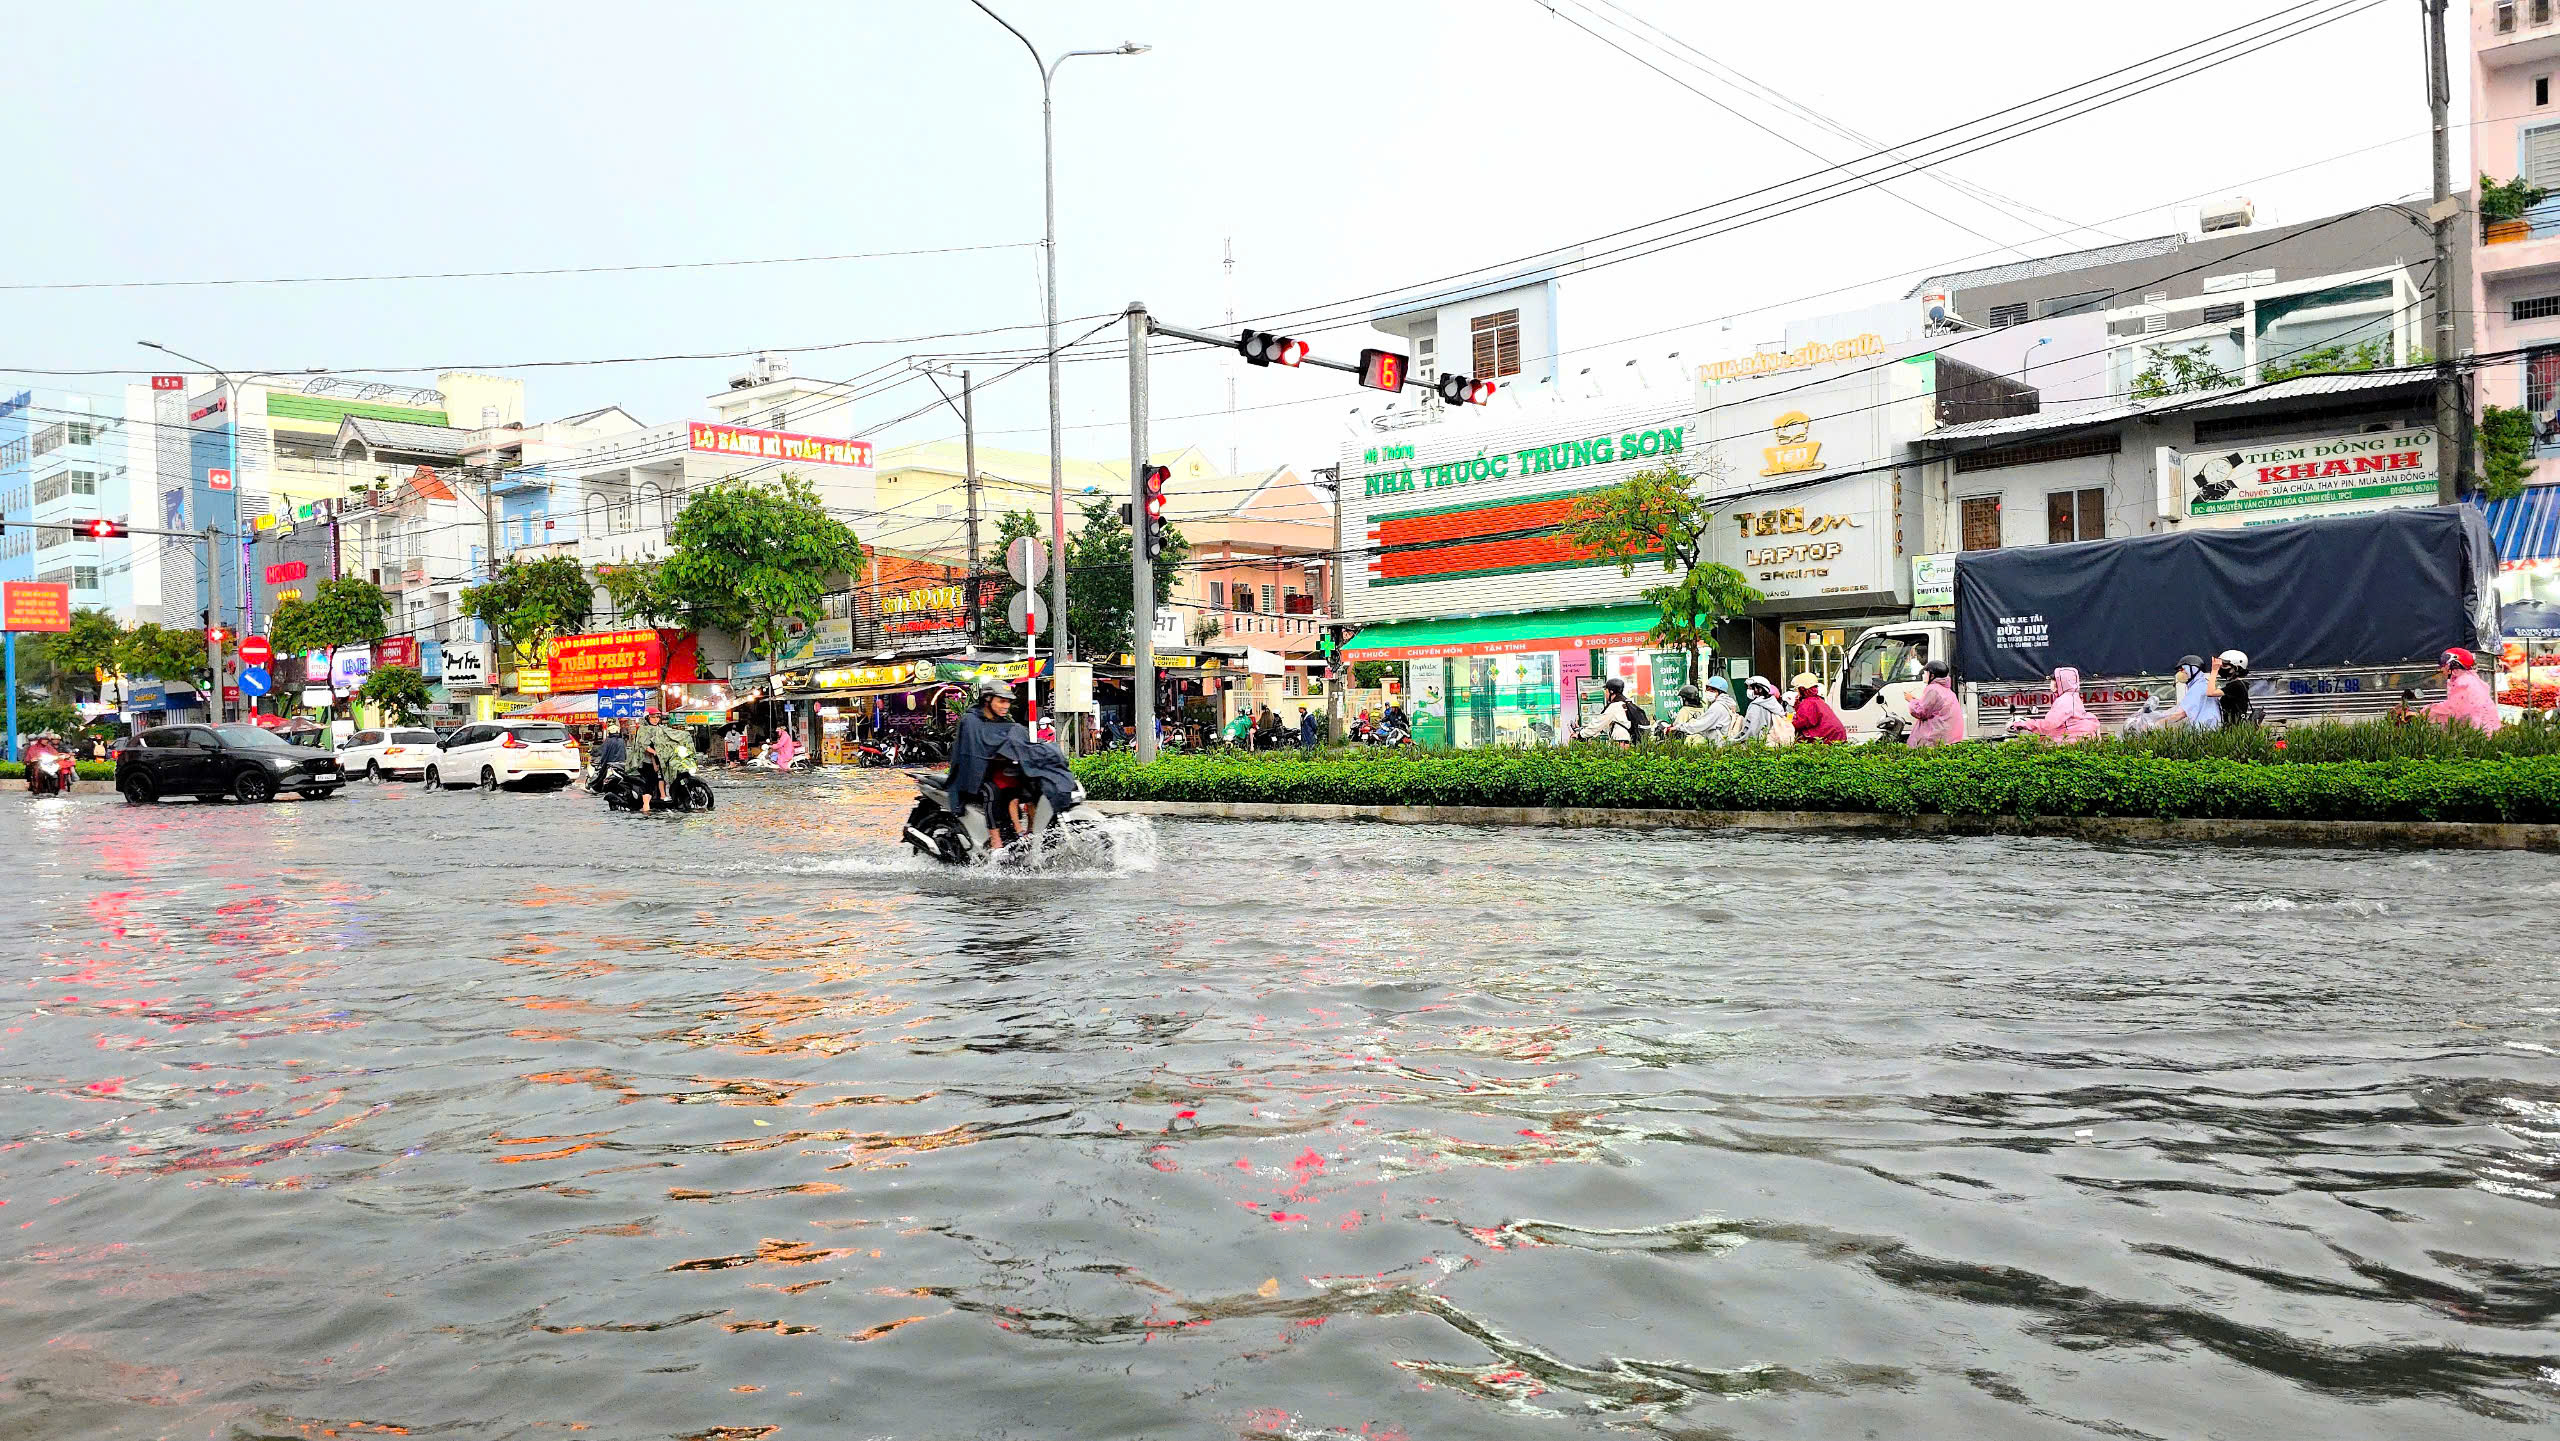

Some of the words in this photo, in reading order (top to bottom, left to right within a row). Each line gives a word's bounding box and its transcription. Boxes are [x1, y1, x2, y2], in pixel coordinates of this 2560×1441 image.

[1381, 358, 1396, 387] 6
[718, 430, 760, 453] BÁNH
[824, 442, 861, 464] PHÁT
[1382, 441, 1415, 461] Thống
[2245, 449, 2305, 465] TIỆM
[2393, 430, 2431, 448] HỒ
[1364, 462, 1416, 496] NHÀ
[1421, 445, 1509, 488] THUỐC
[1517, 437, 1614, 475] TRUNG
[2257, 452, 2423, 485] KHANH
[2239, 489, 2271, 498] Chuyên:
[2272, 484, 2290, 495] SỬA
[2318, 481, 2339, 490] THAY
[2359, 477, 2378, 486] MUA
[2380, 473, 2398, 484] BÁN
[2400, 471, 2426, 481] ĐỒNG
[2217, 501, 2241, 512] NGUYỄN
[2244, 500, 2257, 510] VĂN
[2284, 496, 2297, 505] HÒA
[1746, 542, 1842, 566] LAPTOP
[1760, 568, 1829, 581] GAMING
[1917, 587, 1939, 595] CHUYÊN
[1941, 585, 1953, 594] CÁC
[2030, 614, 2043, 622] TẢI
[1997, 624, 2021, 636] ĐỨC
[2024, 624, 2048, 635] DUY
[1362, 648, 1390, 658] THUỐC
[1407, 647, 1441, 656] CHUYÊN
[1443, 646, 1463, 655] MÔN
[559, 649, 596, 672] TUẤN
[598, 647, 635, 669] PHÁT
[638, 650, 647, 666] 3
[1009, 663, 1028, 672] COFFE
[1660, 664, 1679, 674] ĐIỂM
[2113, 688, 2150, 702] SƠN
